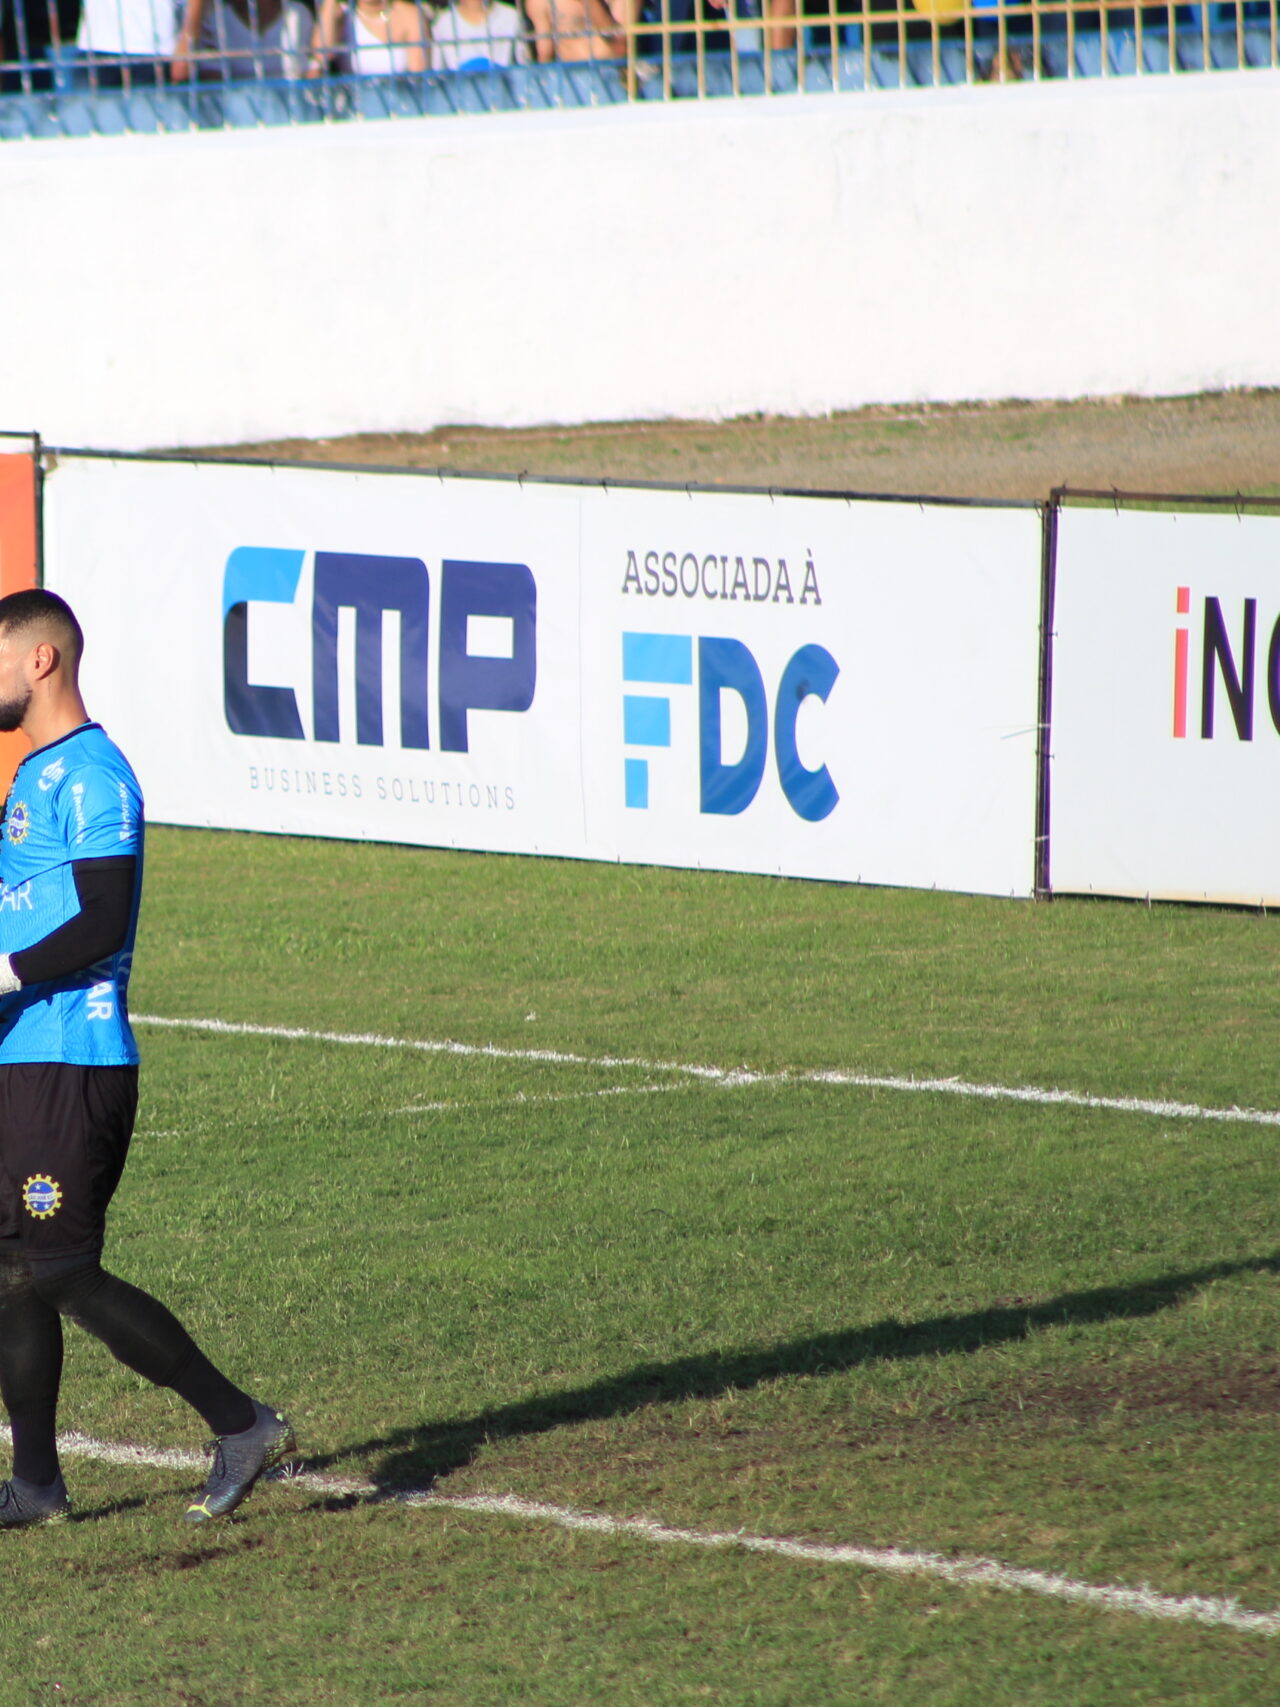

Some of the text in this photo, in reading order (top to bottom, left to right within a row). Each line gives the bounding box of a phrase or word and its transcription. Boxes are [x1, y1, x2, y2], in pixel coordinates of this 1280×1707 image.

[222, 545, 538, 753] CMP
[621, 547, 822, 605] ASSOCIADA À
[621, 631, 841, 822] FDC
[1173, 586, 1280, 742] iN
[248, 765, 517, 811] BUSINESS SOLUTIONS
